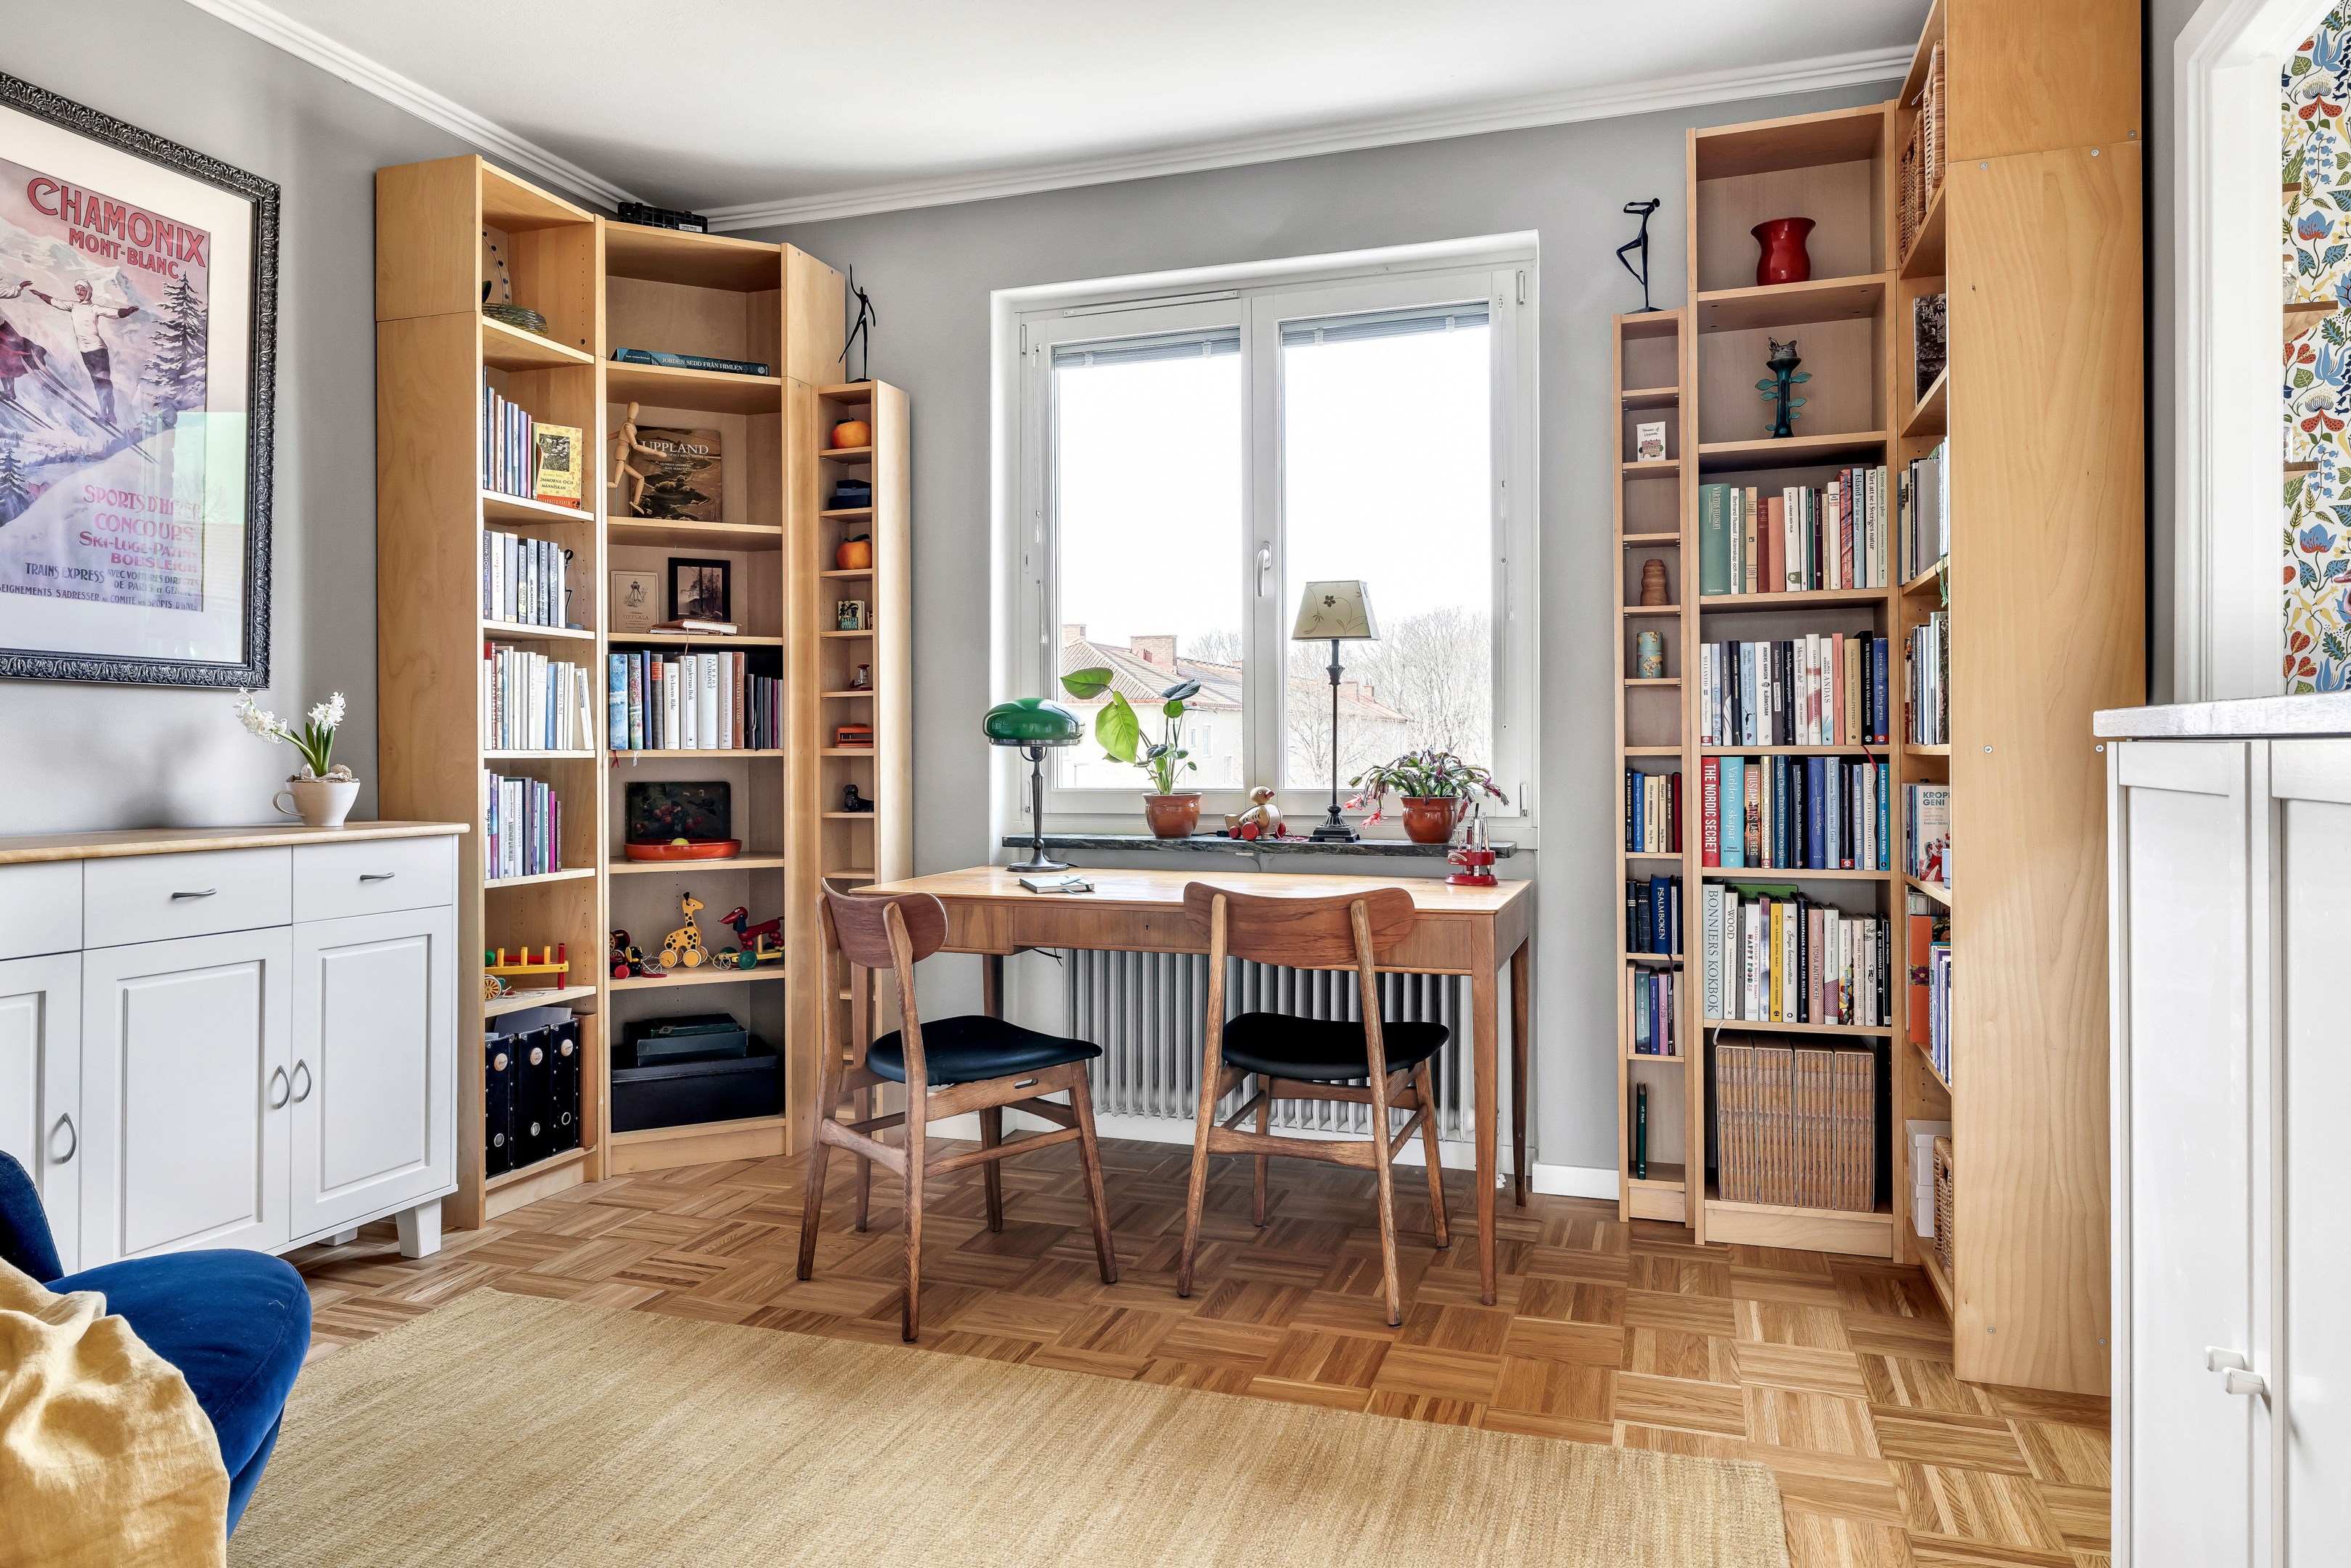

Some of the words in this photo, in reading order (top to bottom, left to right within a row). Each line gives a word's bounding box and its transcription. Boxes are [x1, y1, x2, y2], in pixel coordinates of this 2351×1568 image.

[27, 177, 206, 268] CHAMONIX
[69, 227, 179, 279] MONT-BLANC
[720, 363, 743, 372] HIMLEN
[83, 485, 145, 513] SPORTS
[94, 513, 194, 542] CONCOURS
[25, 562, 60, 579] TRAINS
[62, 566, 105, 584] EXPRESS
[107, 568, 126, 579] AVEC
[126, 571, 163, 584] VOITURES
[114, 580, 124, 589] DE
[128, 581, 153, 592] PARIS
[56, 589, 99, 602] S'ADRESSER
[147, 598, 173, 609] SPORTS
[176, 601, 198, 611] D'HIVER
[1704, 764, 1716, 781] THE
[1728, 766, 1738, 802] Världen
[1704, 784, 1717, 817] NORDIC
[1747, 769, 1758, 821] TILLSAMMANS
[1704, 819, 1717, 854] SECRET
[1726, 809, 1738, 841] skapar
[1657, 887, 1666, 939] PSALMBOKEN
[1708, 890, 1719, 956] BONNIERS
[1727, 909, 1735, 939] WOOD
[1708, 960, 1719, 1013] KOKBOK
